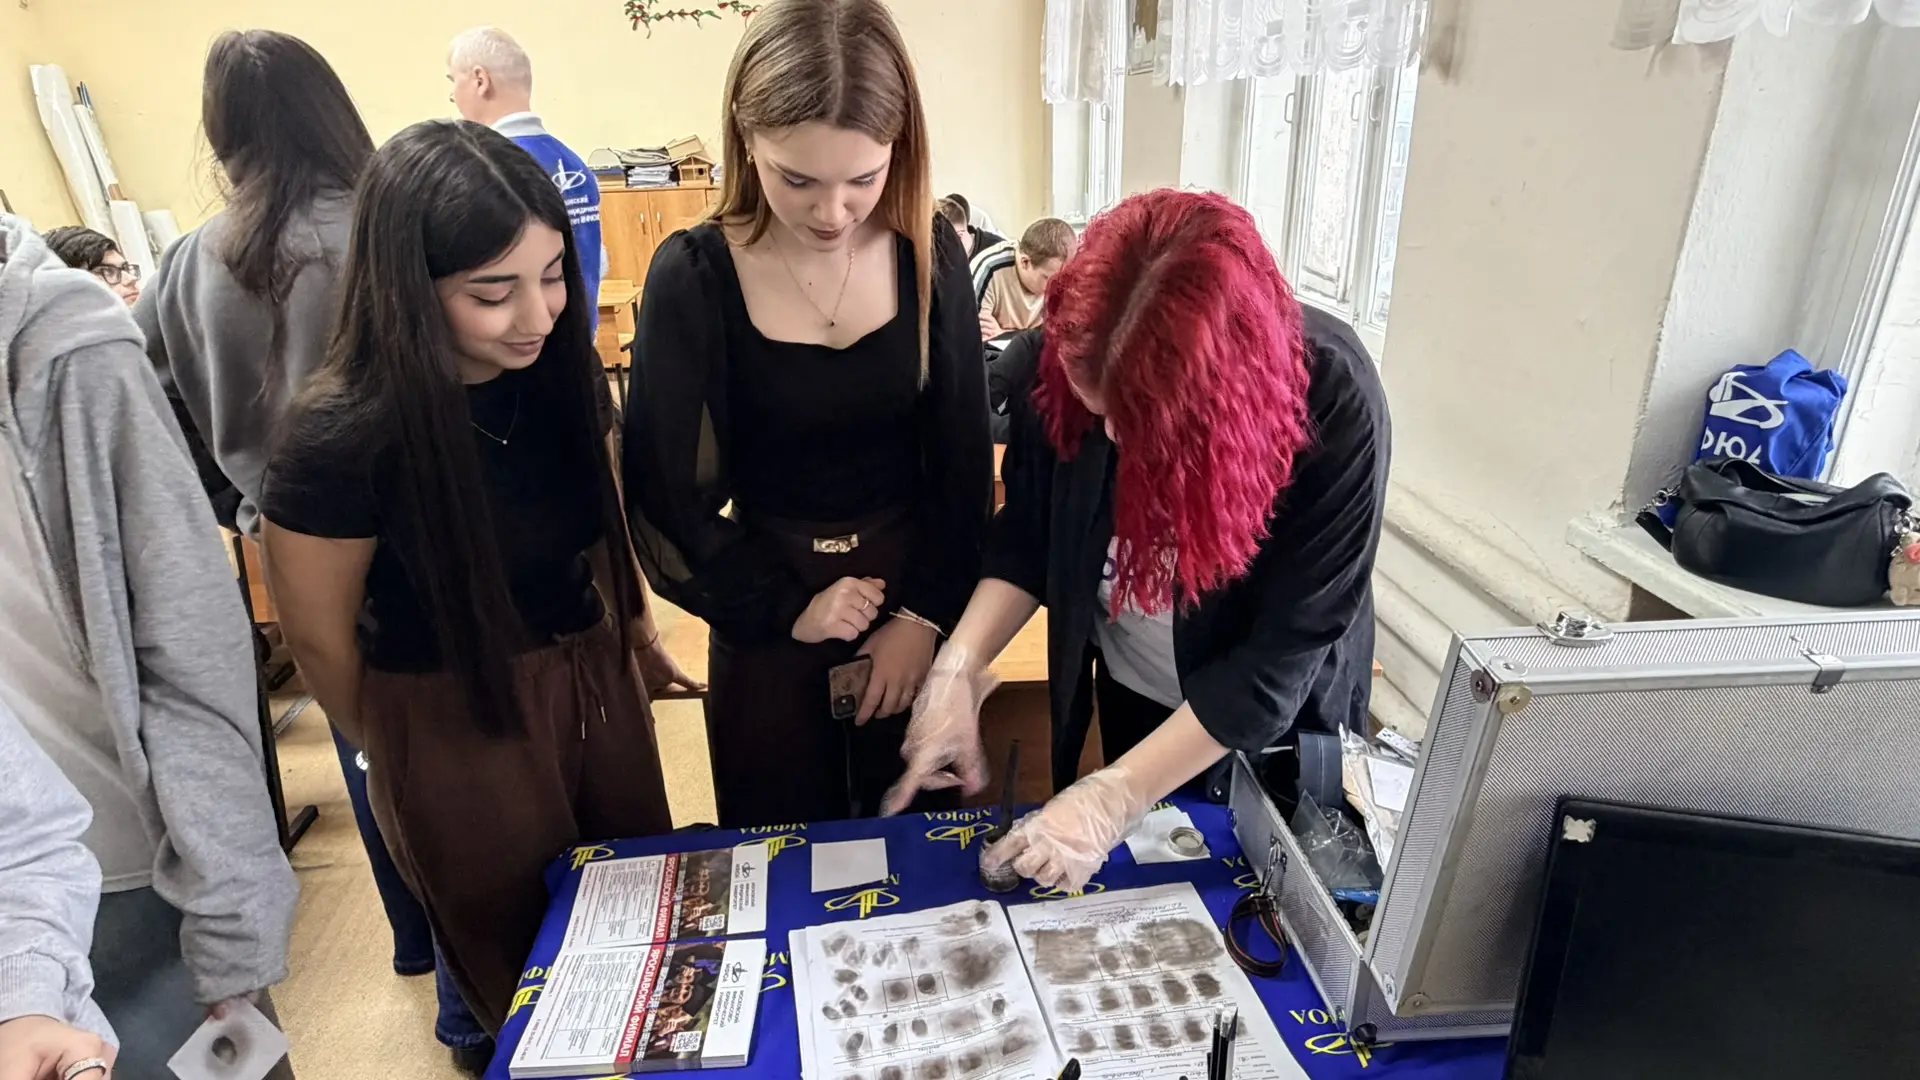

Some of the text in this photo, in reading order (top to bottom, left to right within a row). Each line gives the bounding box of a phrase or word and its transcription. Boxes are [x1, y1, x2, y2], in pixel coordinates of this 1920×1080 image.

[923, 808, 992, 822] МФЮА
[655, 856, 676, 939] ЯРОСЛАВСКИЙ ФИЛИАЛ
[618, 948, 660, 1057] ЯРОСЛАВСКИЙ ФИЛИАЛ
